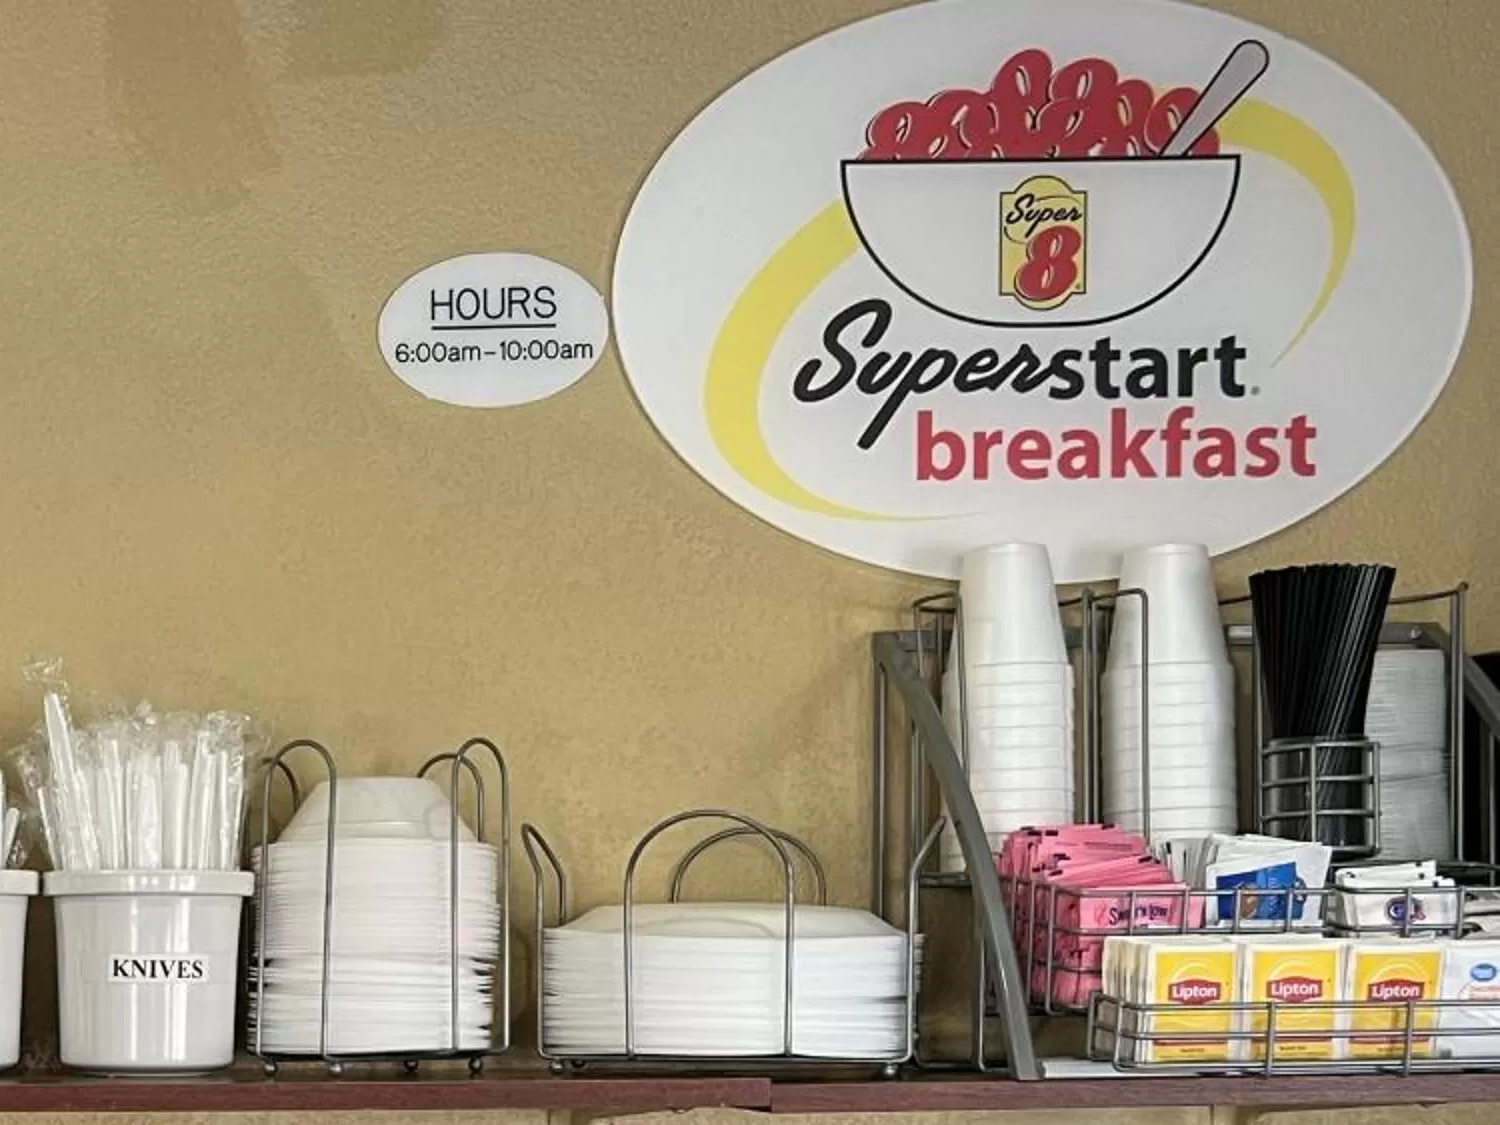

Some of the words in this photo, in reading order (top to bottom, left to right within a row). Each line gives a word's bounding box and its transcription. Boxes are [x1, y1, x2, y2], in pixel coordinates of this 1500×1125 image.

[1004, 193, 1082, 238] Super
[1013, 225, 1082, 302] 8
[431, 286, 557, 321] HOURS
[793, 299, 1247, 449] Superstart
[916, 406, 1317, 481] breakfast
[112, 958, 204, 980] KNIVES
[1172, 984, 1217, 999] Lipton
[1271, 982, 1320, 997] Lipton
[1371, 984, 1420, 999] Lipton
